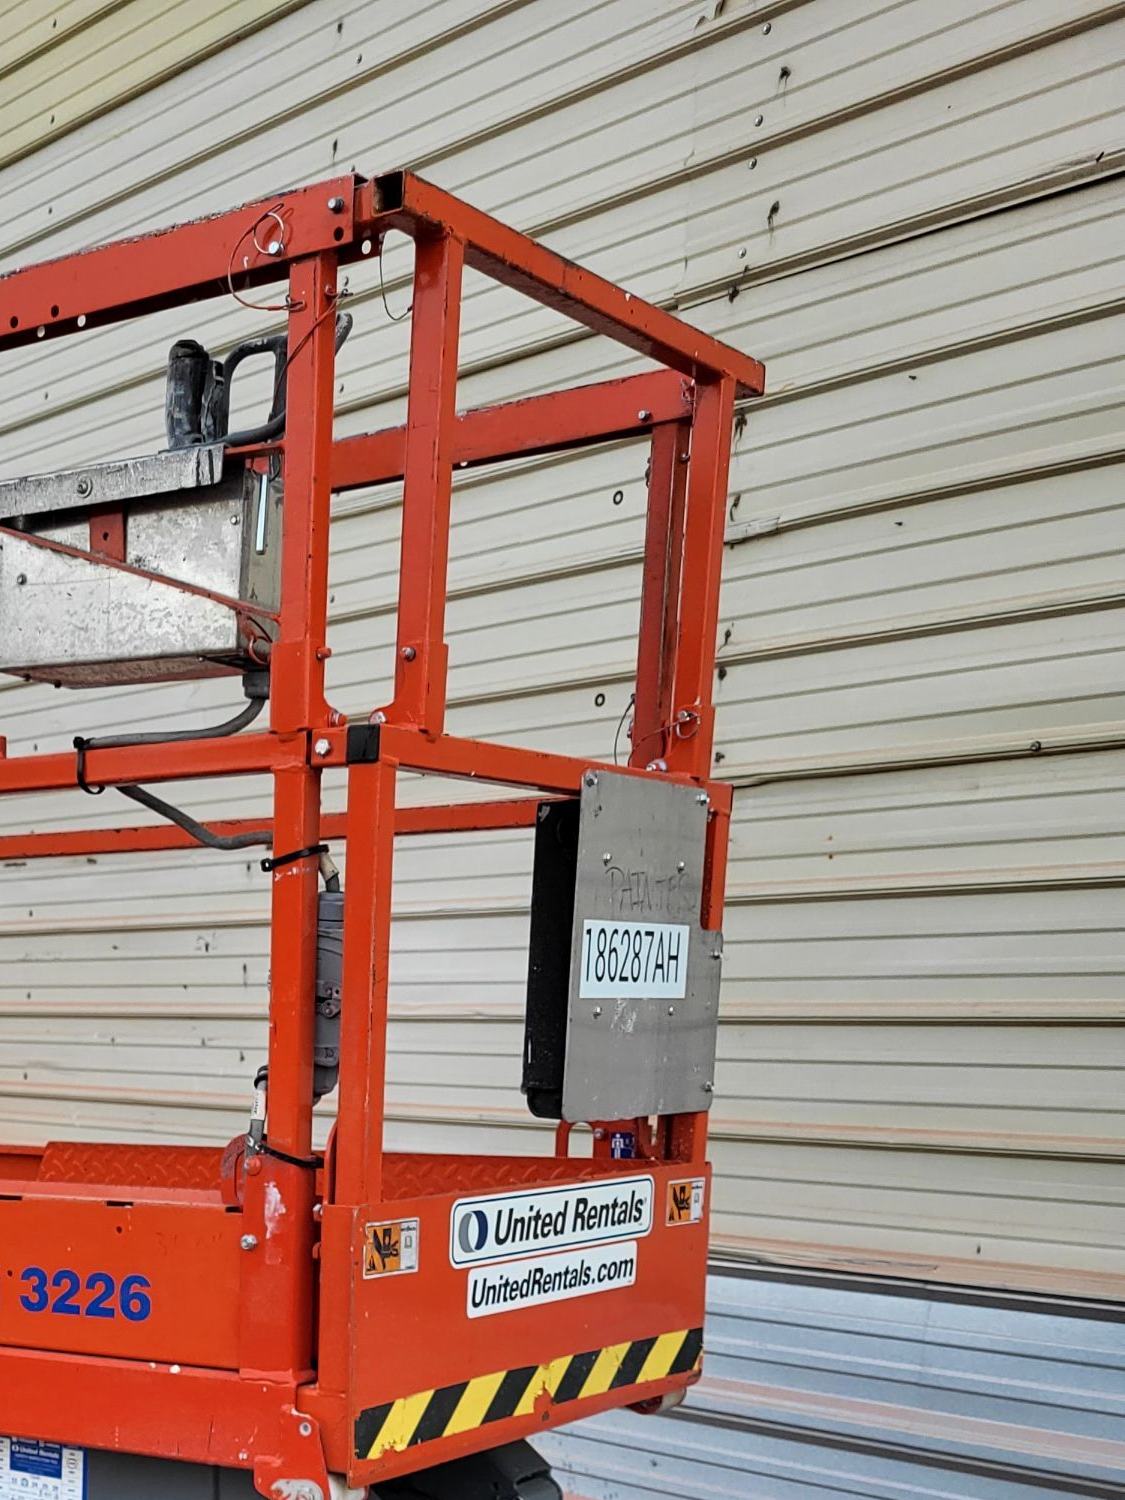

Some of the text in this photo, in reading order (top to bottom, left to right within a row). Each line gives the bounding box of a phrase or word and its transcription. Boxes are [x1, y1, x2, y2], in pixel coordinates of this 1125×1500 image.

[585, 927, 681, 984] 186287AH
[493, 1190, 643, 1247] United Rentals
[19, 1267, 153, 1322] 3226
[471, 1256, 635, 1309] UnitedRentals.com
